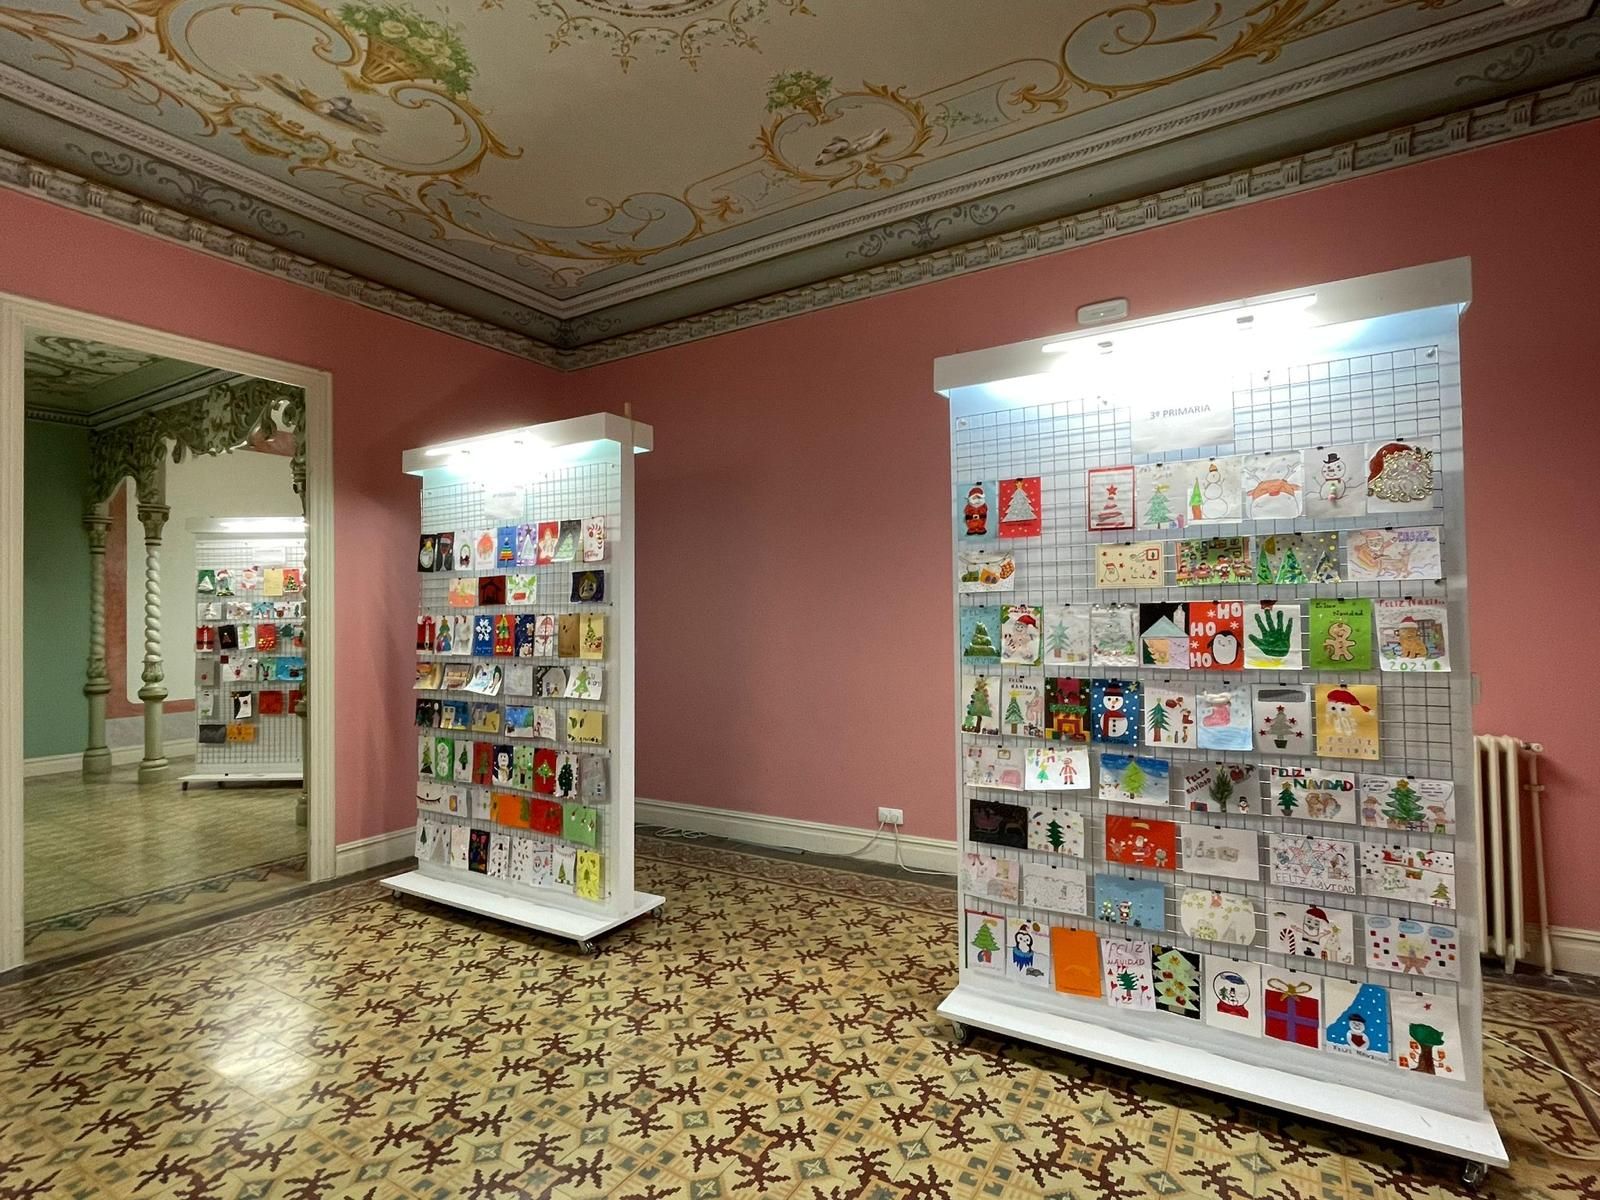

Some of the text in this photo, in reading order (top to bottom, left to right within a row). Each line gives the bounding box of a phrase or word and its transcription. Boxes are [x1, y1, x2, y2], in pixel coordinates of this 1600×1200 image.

[1162, 404, 1211, 418] PRIMARIA
[1216, 602, 1242, 619] HO
[1190, 621, 1217, 637] HO
[1190, 651, 1212, 668] HO
[1185, 767, 1210, 784] FELIZ
[1271, 766, 1304, 777] FELIZ
[1275, 871, 1309, 886] FELIZ
[1109, 942, 1143, 959] FELIZ
[1107, 958, 1146, 966] NAVIDAD
